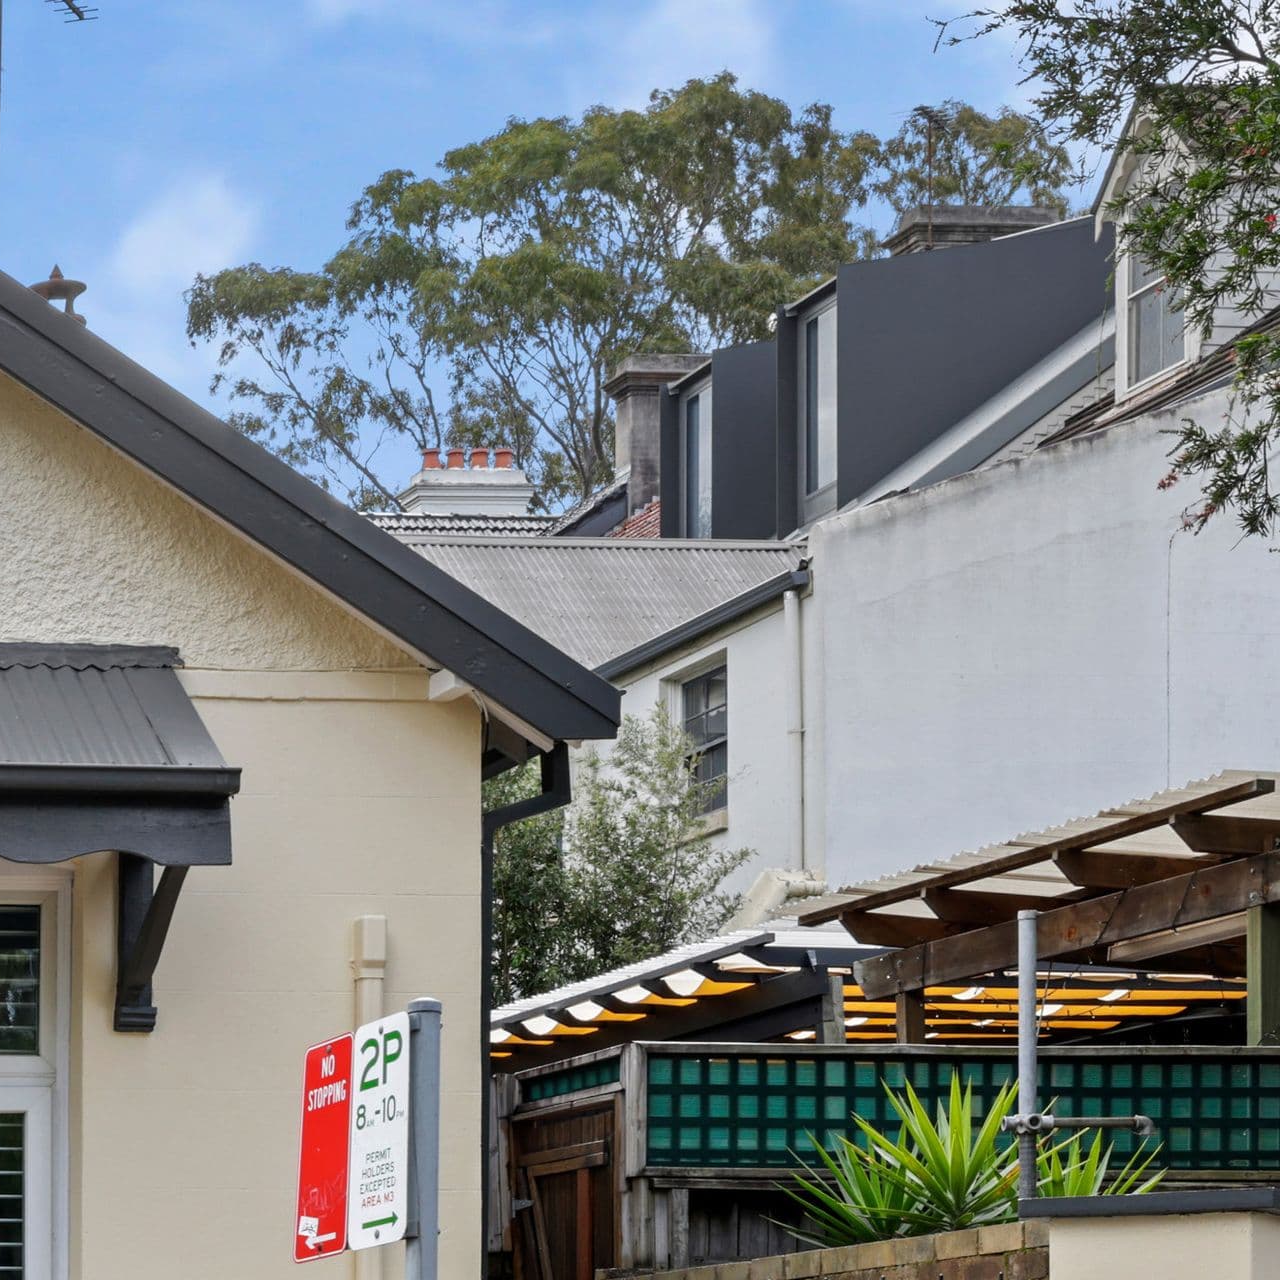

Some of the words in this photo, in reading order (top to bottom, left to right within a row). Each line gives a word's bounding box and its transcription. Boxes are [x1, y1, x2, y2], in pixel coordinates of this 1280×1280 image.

[321, 1054, 335, 1079] NO
[360, 1030, 403, 1091] 2P
[308, 1079, 346, 1111] STOPPING
[366, 1147, 391, 1164] PERMIT
[362, 1161, 395, 1180] HOLDERS
[360, 1176, 396, 1195] EXCEPTED
[362, 1194, 382, 1208] AREA
